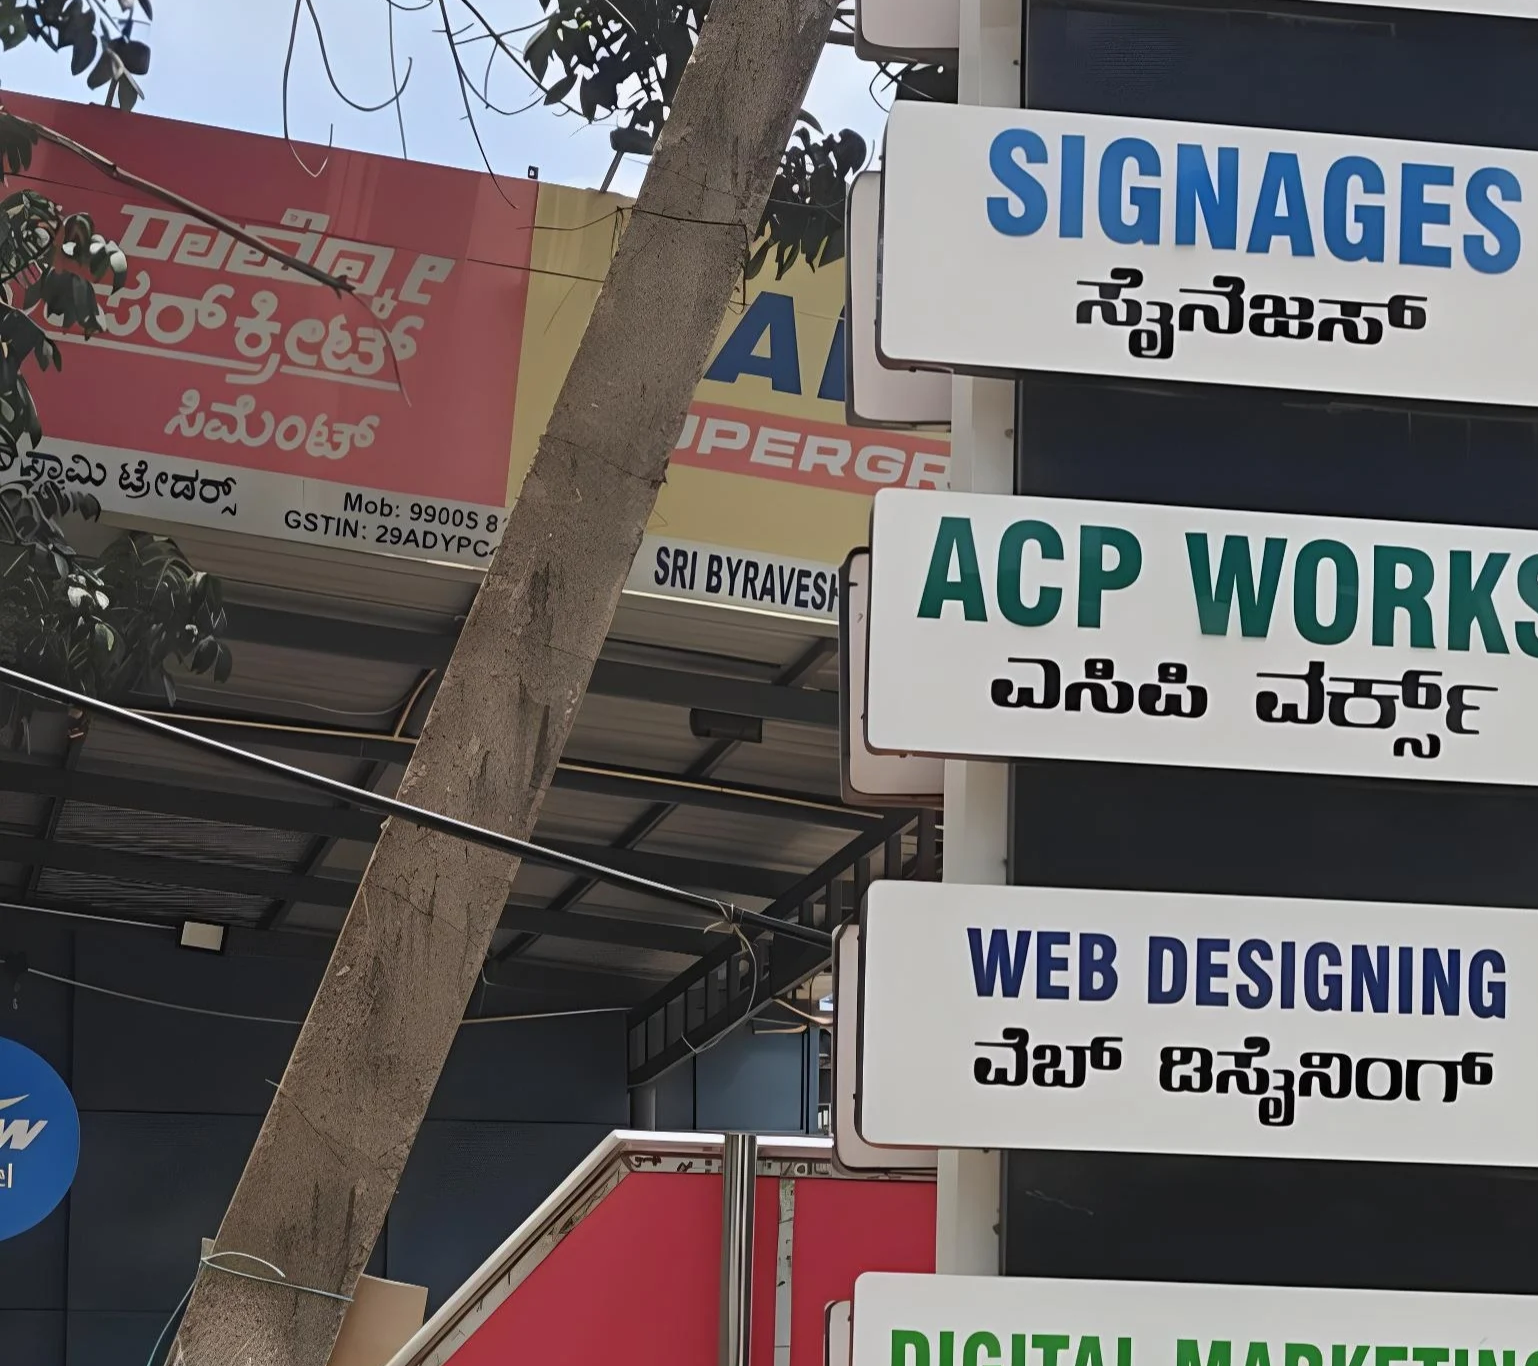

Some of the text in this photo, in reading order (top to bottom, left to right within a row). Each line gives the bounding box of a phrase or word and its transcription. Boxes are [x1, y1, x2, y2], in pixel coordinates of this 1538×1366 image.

[986, 128, 1523, 276] SIGNAGES
[284, 509, 368, 540] GSTIN:
[343, 491, 401, 519] Mob:
[409, 502, 479, 530] 99005
[654, 545, 698, 590] SRI
[917, 516, 1143, 629] ACP
[990, 656, 1208, 719] ಎಸಿಪಿ
[967, 927, 1508, 1020] WEB DESIGNING
[973, 1027, 1495, 1128] ವೆಬ್ ಡಿಸೈನಿಂಗ್
